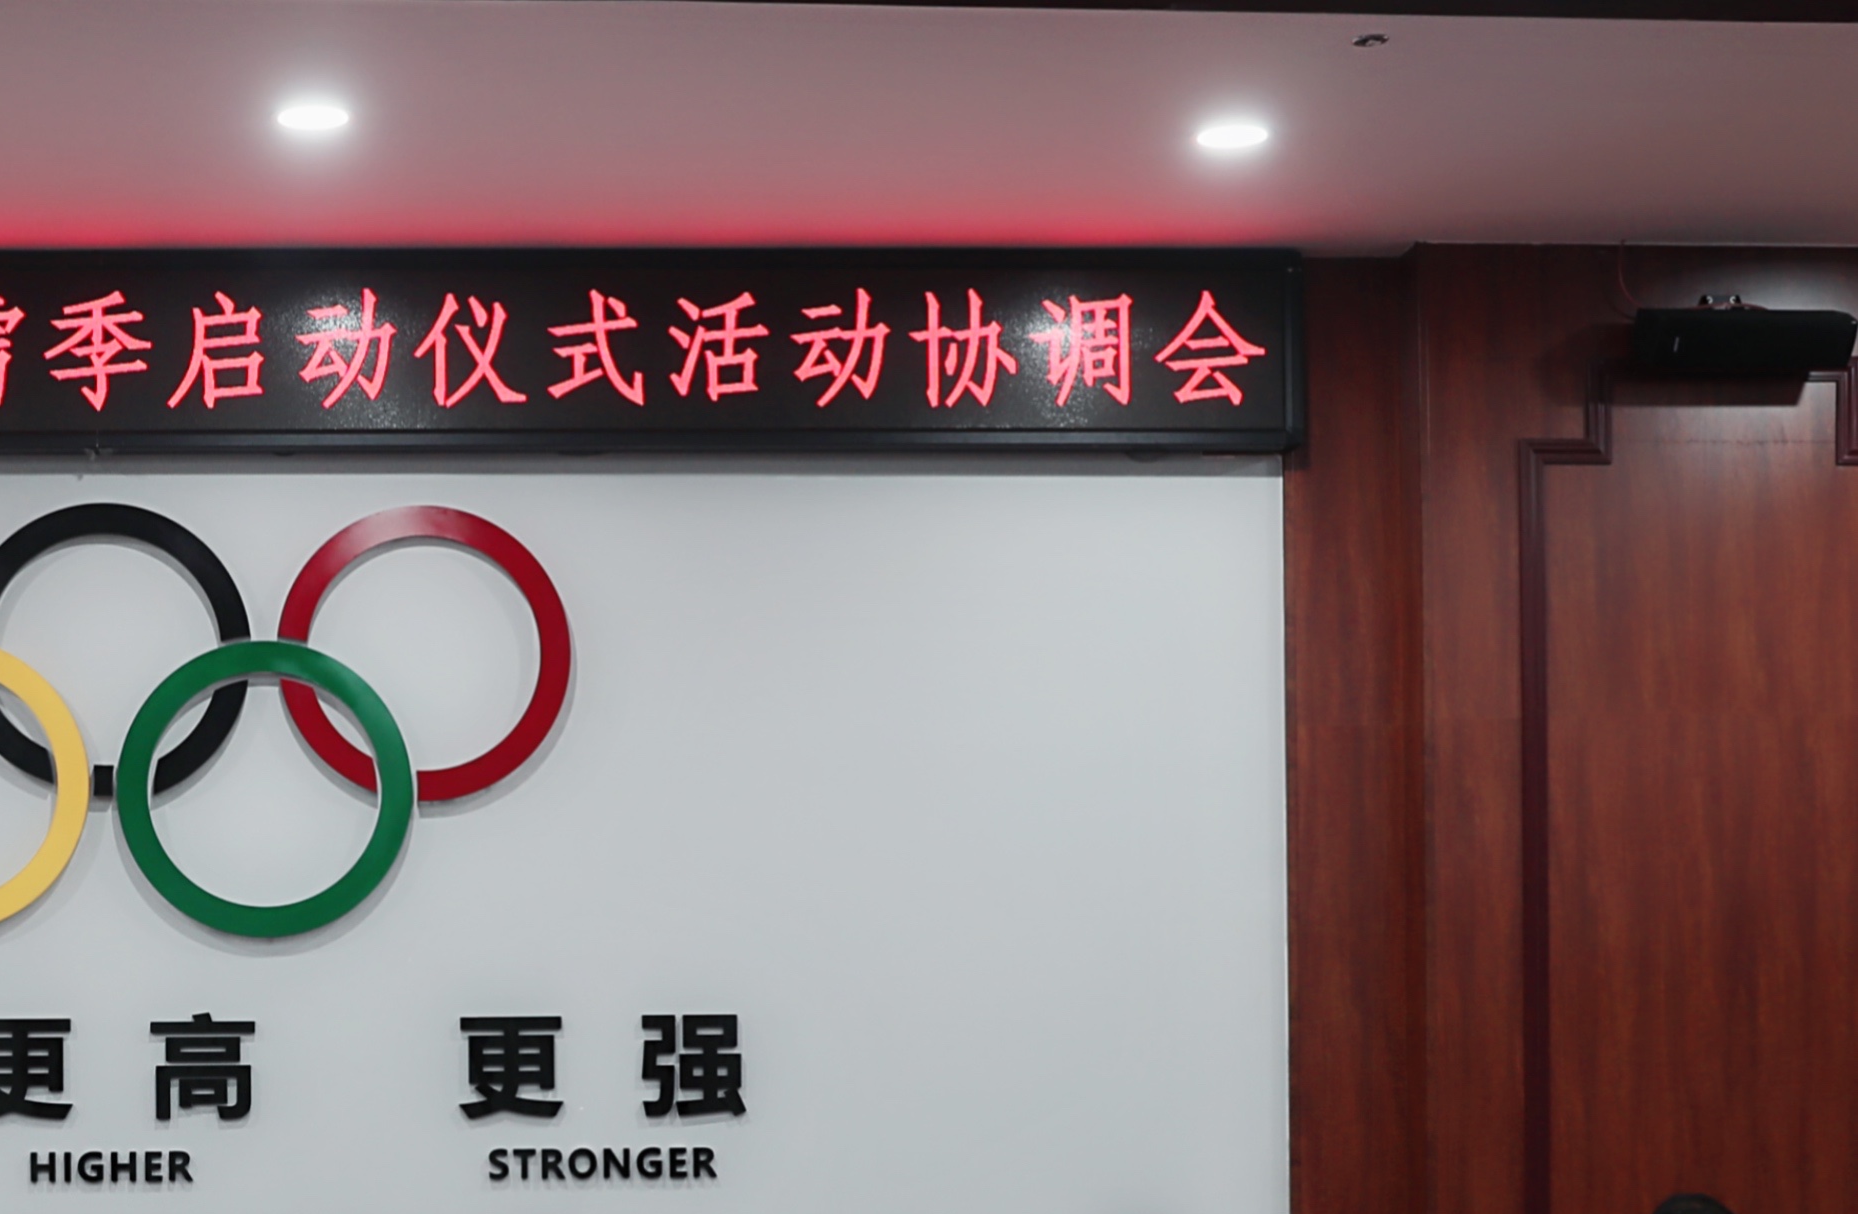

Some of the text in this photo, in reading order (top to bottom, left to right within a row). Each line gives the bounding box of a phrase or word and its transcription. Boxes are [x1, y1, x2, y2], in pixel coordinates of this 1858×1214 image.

[459, 1013, 747, 1120] 更强
[30, 1150, 193, 1185] HIGHER
[488, 1147, 717, 1183] STRONGER
